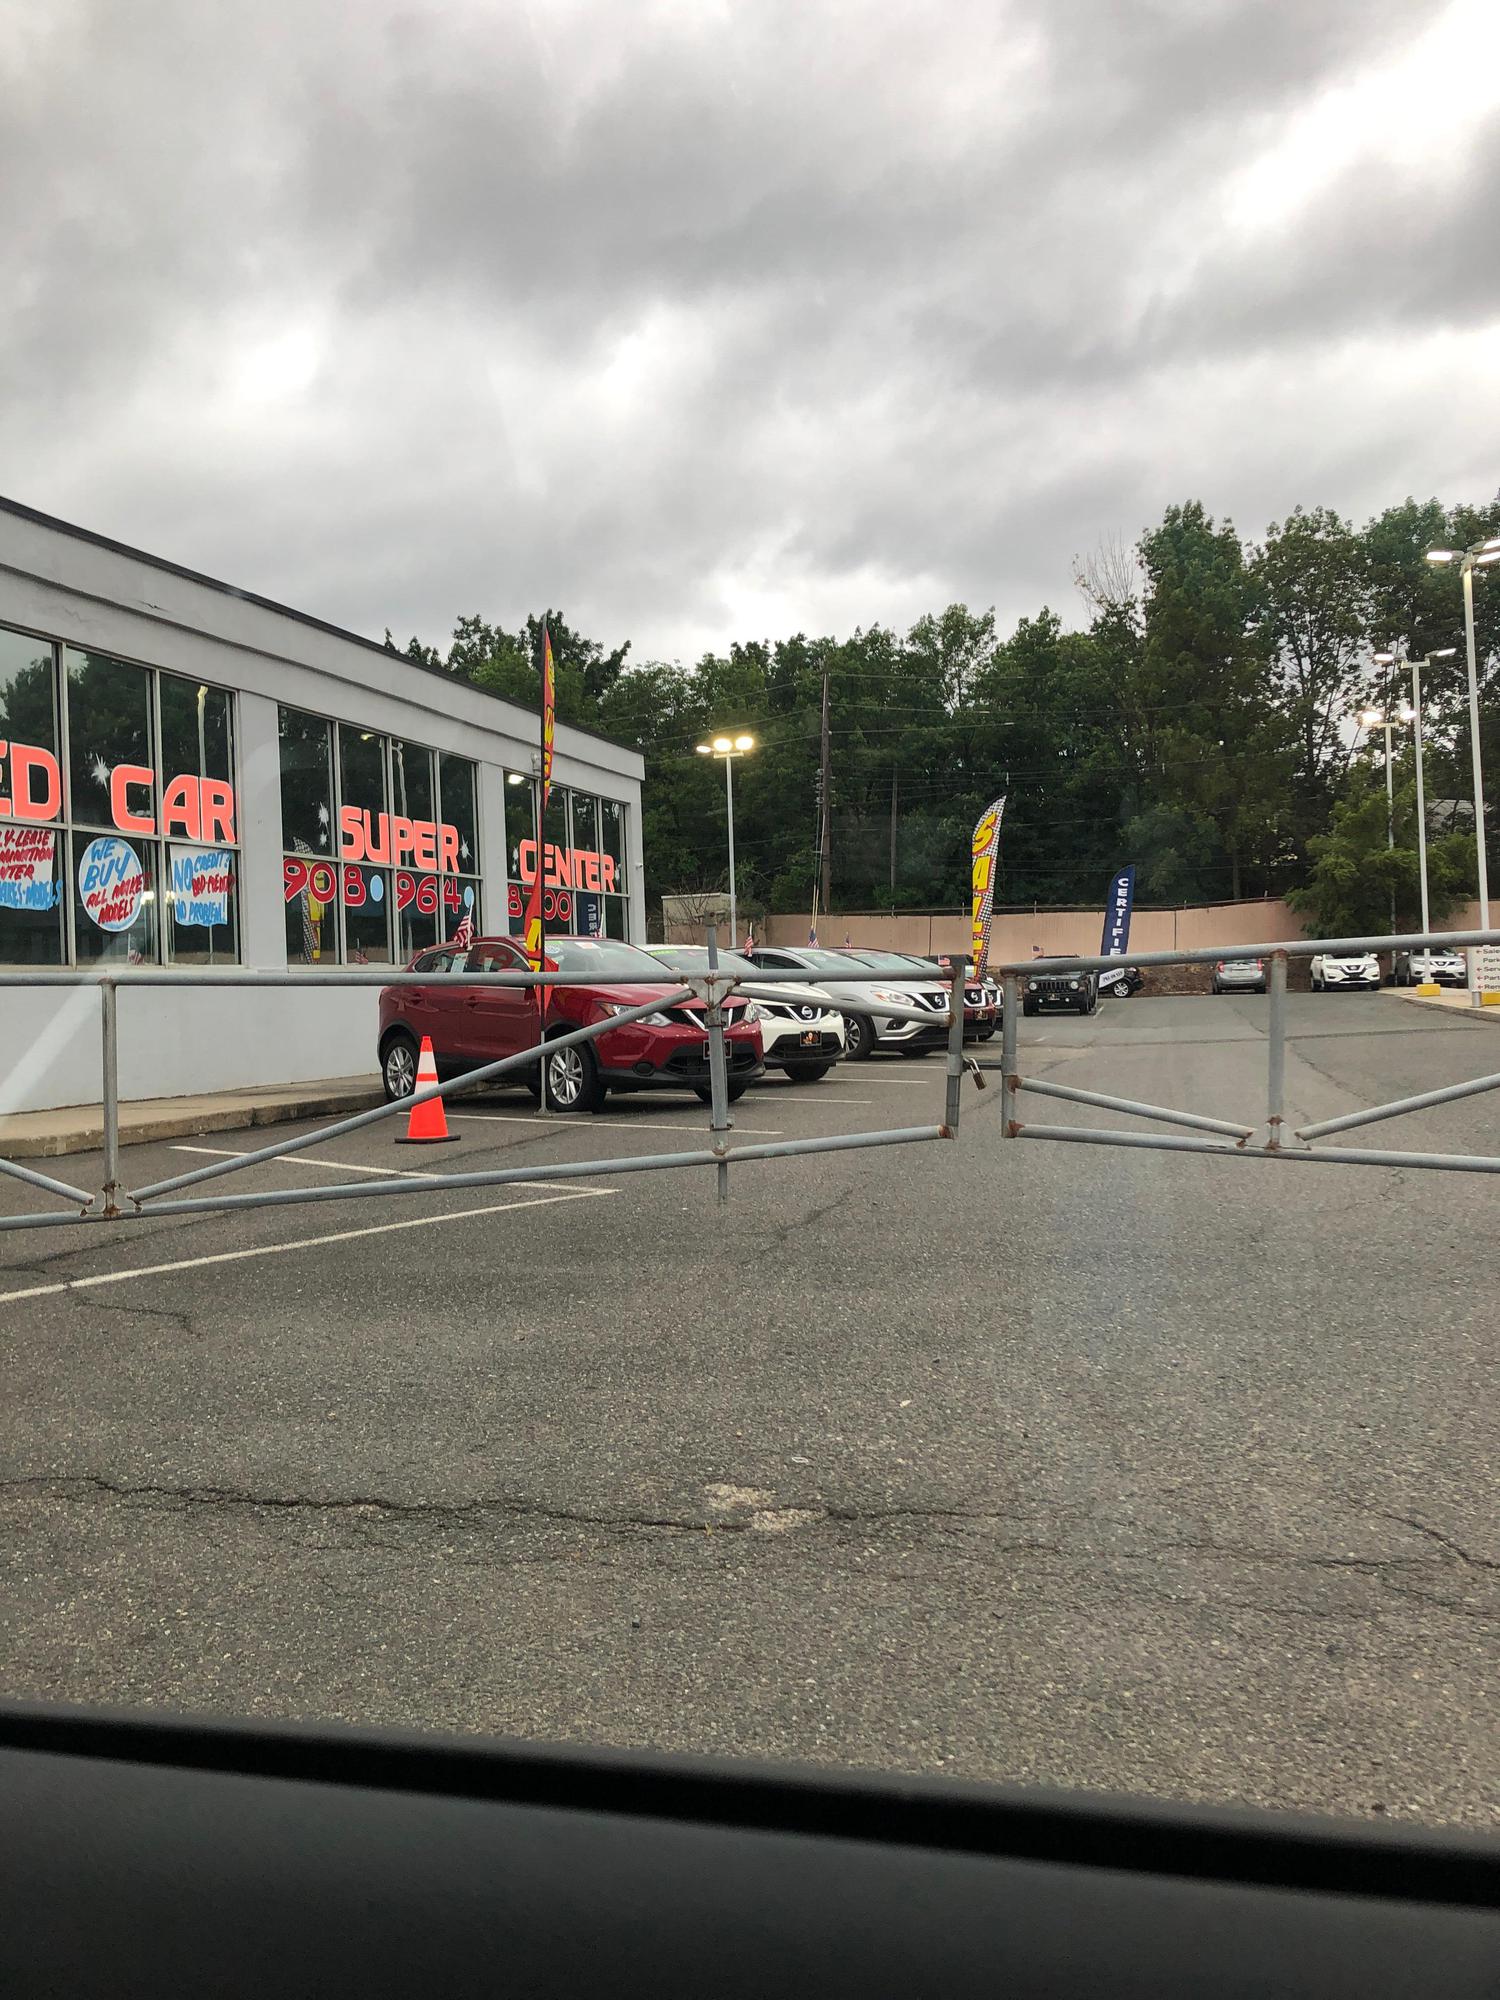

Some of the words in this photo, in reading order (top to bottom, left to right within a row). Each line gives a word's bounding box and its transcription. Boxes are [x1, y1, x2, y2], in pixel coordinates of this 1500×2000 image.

[0, 740, 60, 821] D
[111, 764, 235, 843] CAR
[341, 805, 459, 873] SUPER
[519, 839, 614, 893] CENTER
[0, 829, 51, 848] Y-LEASE
[92, 839, 117, 862] WE
[84, 852, 131, 891] BUY
[174, 858, 194, 892] NO
[86, 888, 107, 909] ALL
[284, 857, 367, 906] 908
[396, 871, 461, 914] 964
[508, 884, 572, 922] 800
[972, 811, 997, 978] SALE
[98, 897, 134, 924] MODELS
